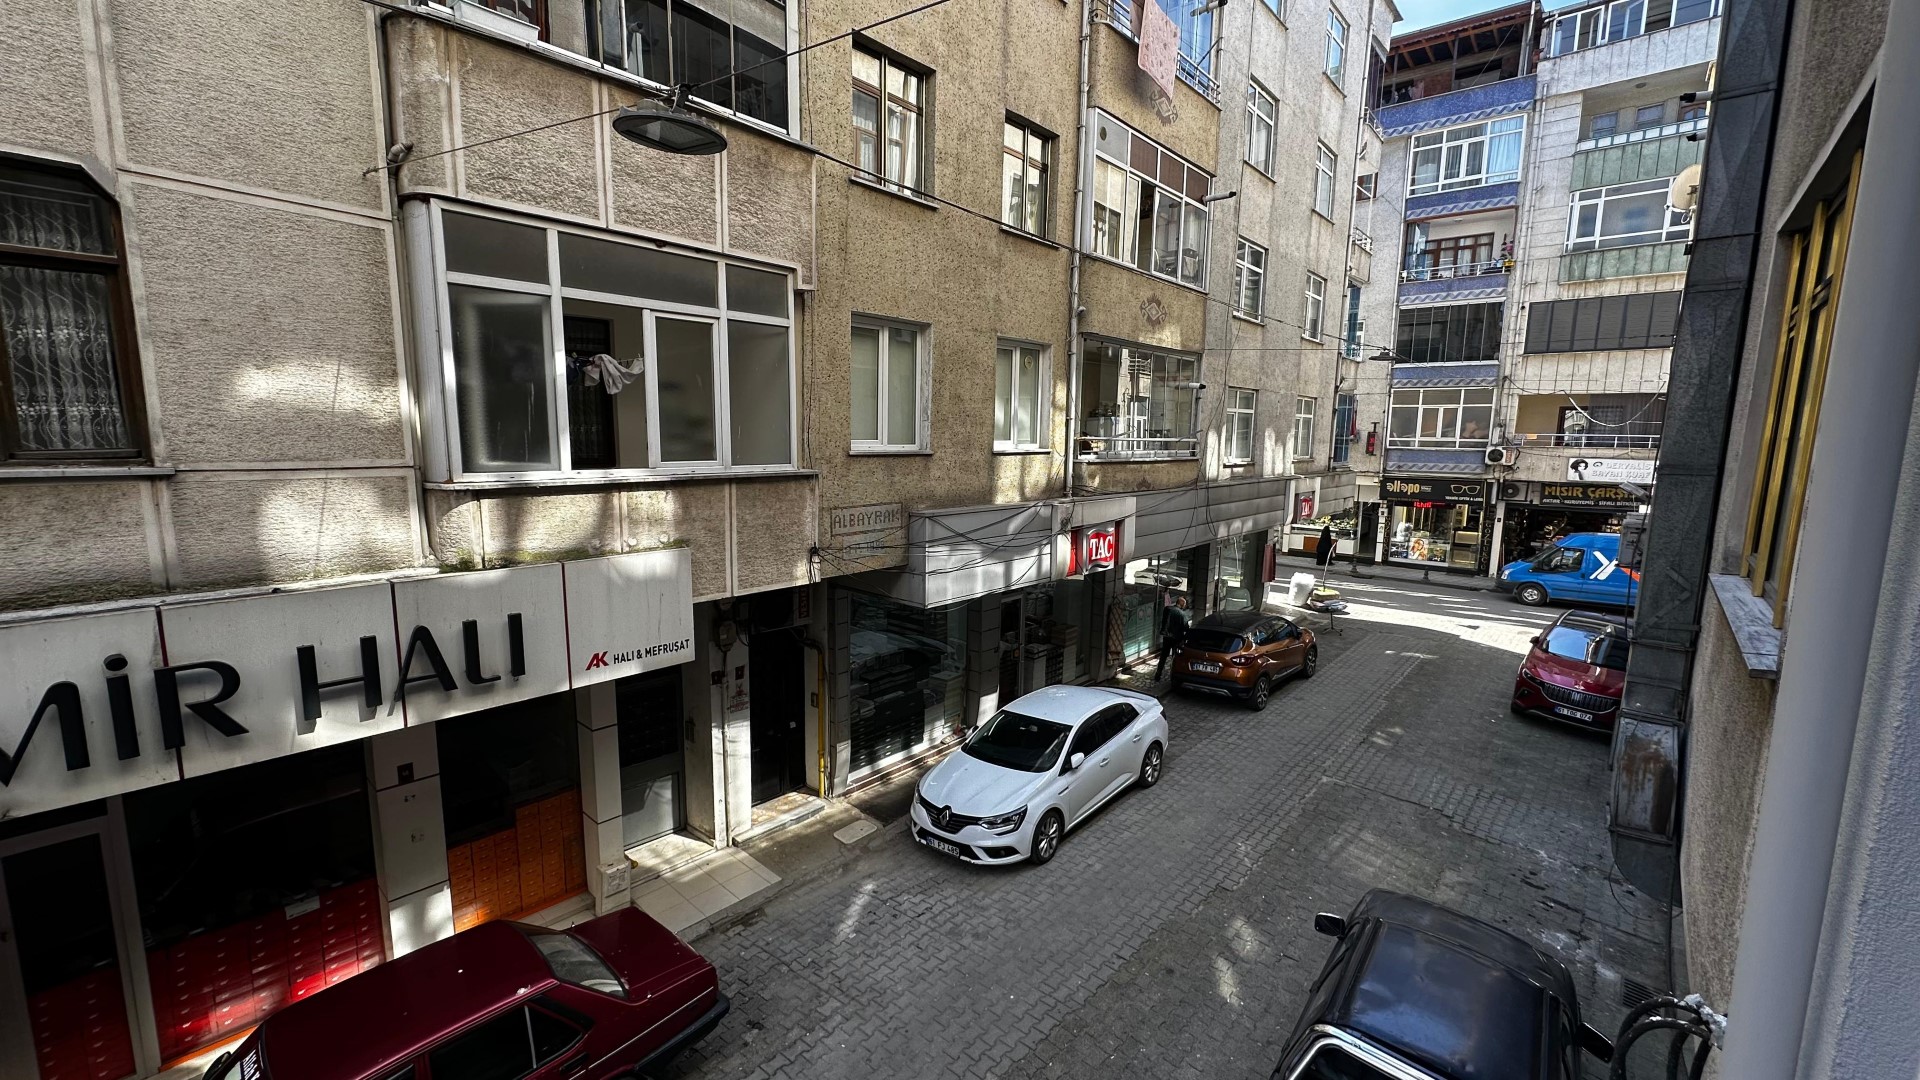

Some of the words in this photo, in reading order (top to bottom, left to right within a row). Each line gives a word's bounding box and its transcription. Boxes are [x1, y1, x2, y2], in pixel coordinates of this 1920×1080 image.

[1544, 486, 1583, 498] MISIR
[833, 508, 900, 529] ALBAYRAK
[585, 650, 610, 671] AK
[613, 650, 635, 665] HALI
[636, 649, 643, 660] &
[644, 638, 690, 658] MEFRUŞAT
[296, 612, 526, 720] HALI
[1579, 713, 1592, 721] 074
